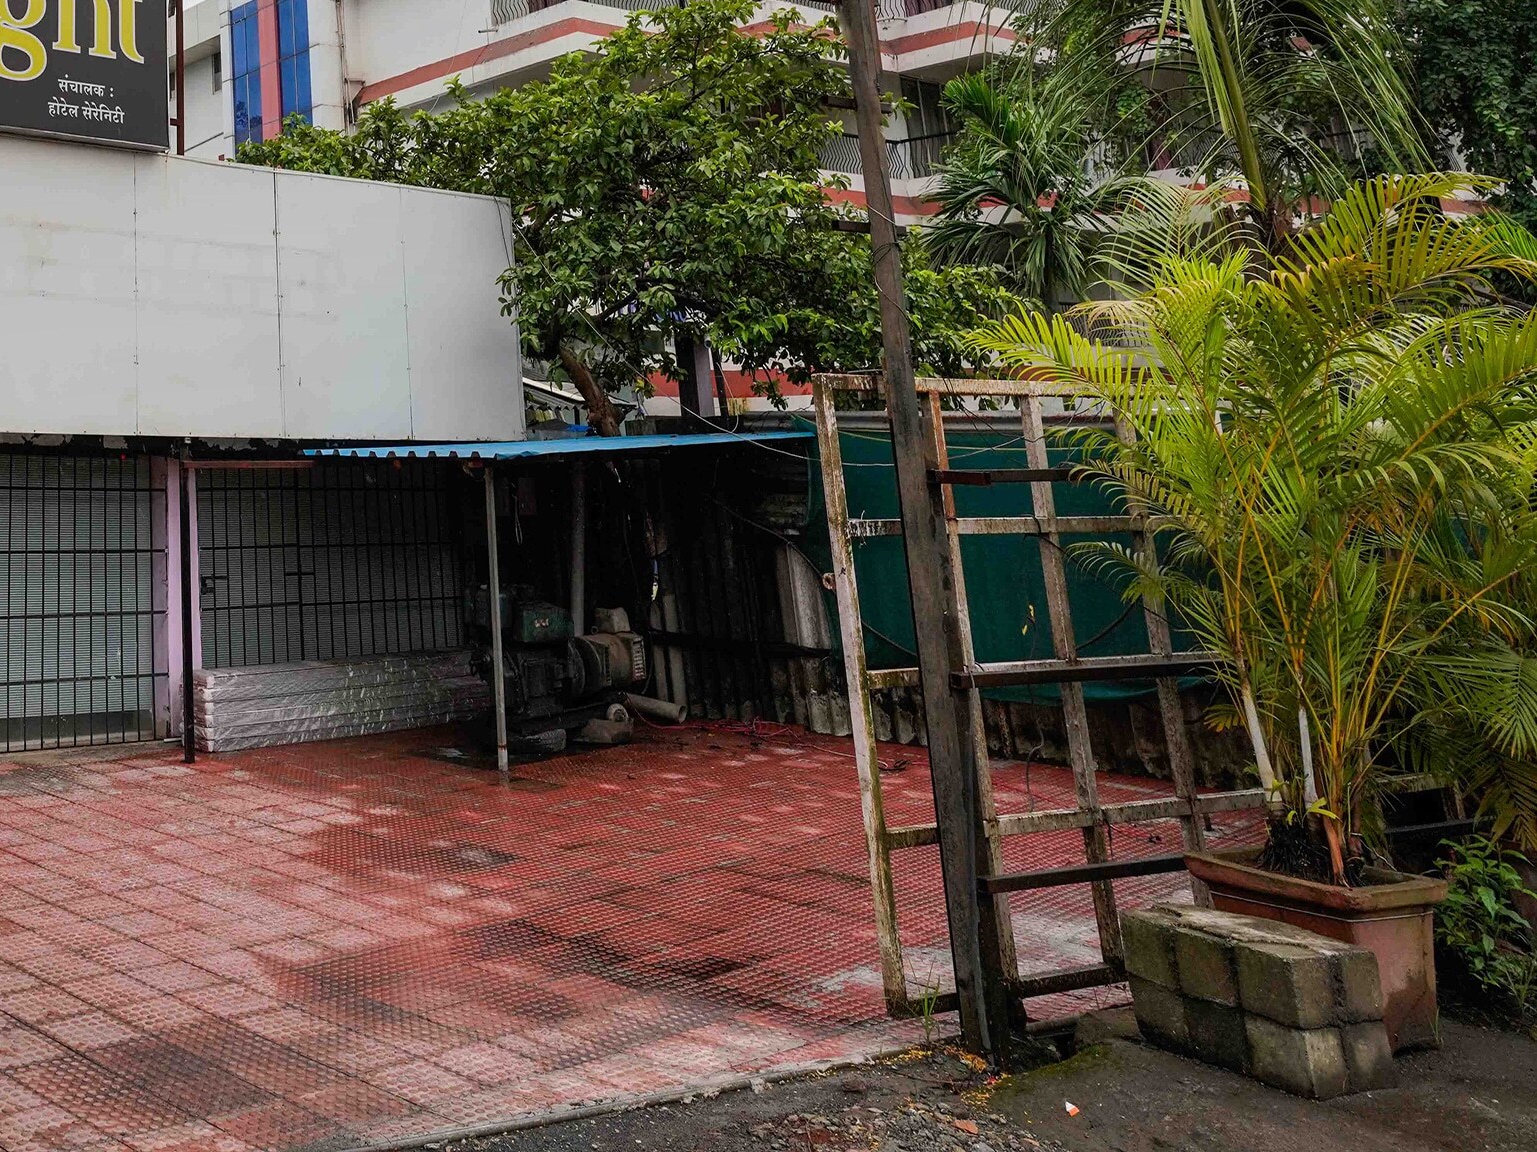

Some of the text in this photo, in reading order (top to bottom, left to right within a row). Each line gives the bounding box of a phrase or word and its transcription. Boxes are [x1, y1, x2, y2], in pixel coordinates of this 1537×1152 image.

[57, 74, 106, 98] संचालक
[47, 96, 126, 125] होटेल सेरेनिटी
